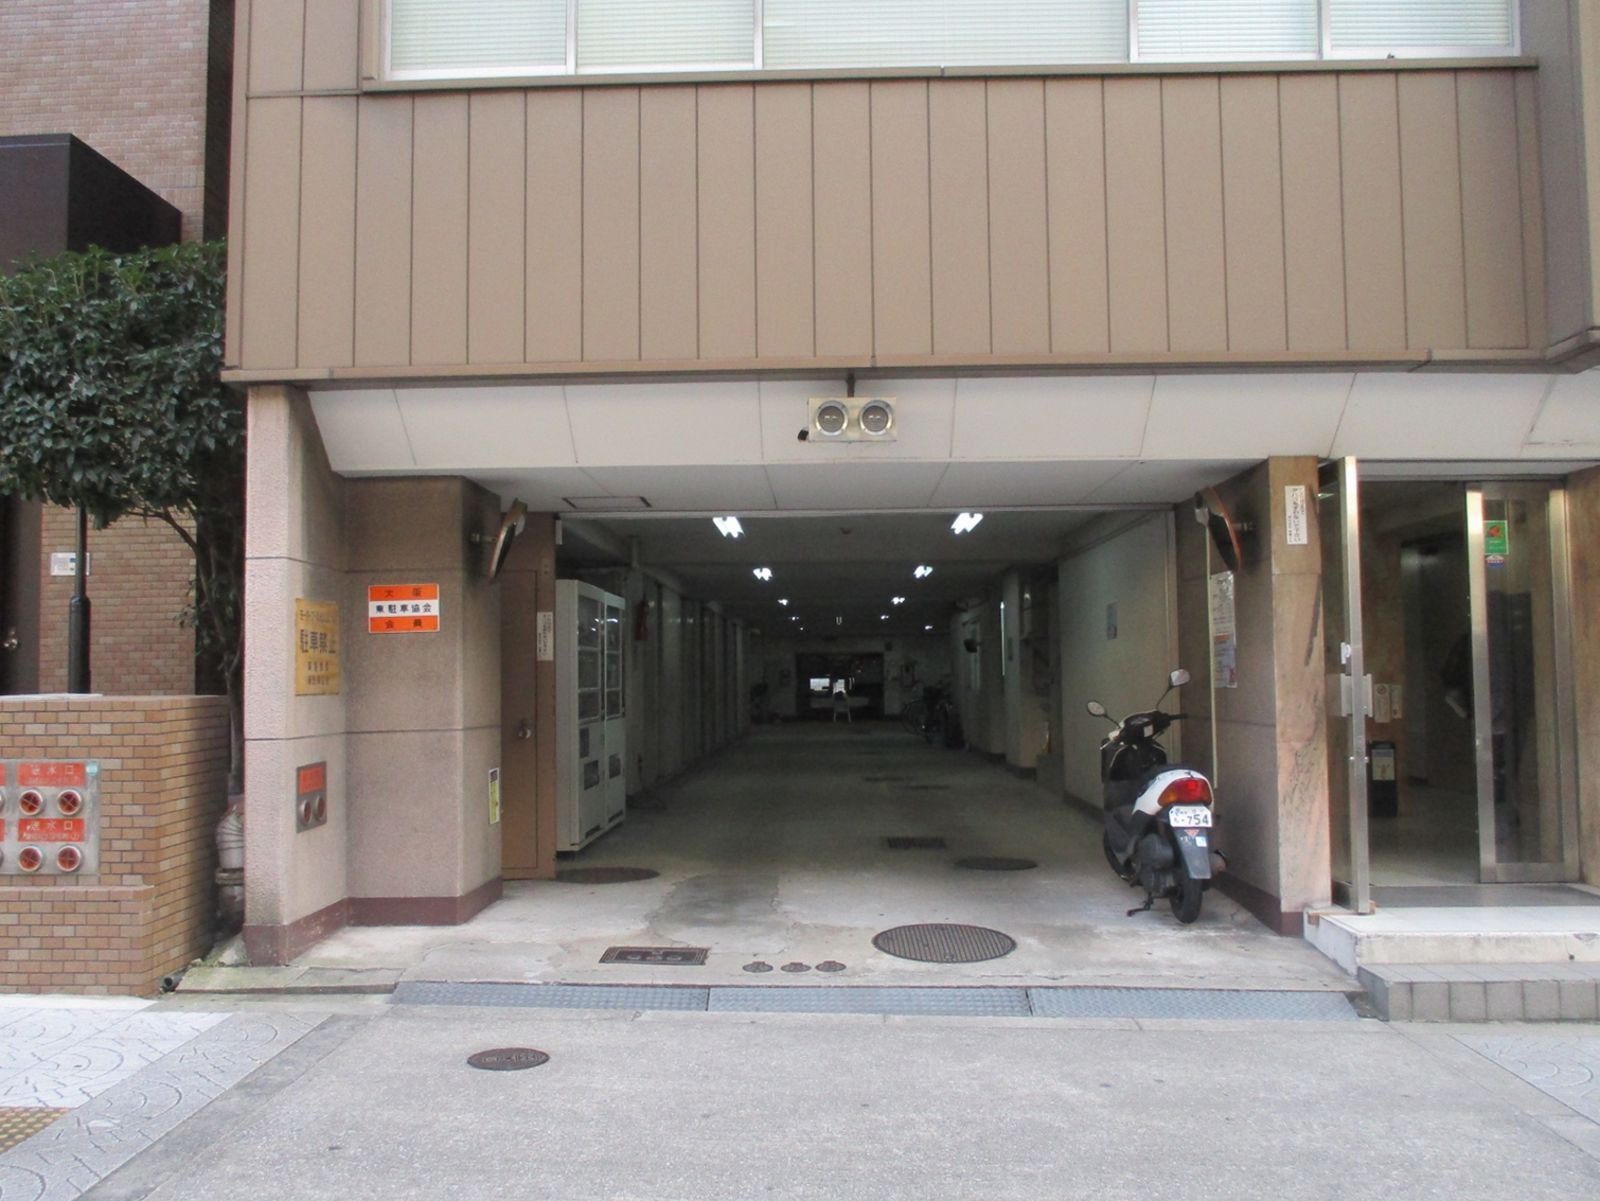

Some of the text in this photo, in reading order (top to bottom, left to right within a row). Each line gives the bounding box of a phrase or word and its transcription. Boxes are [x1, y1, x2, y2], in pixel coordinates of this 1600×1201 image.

[376, 603, 431, 614] 東駐車協会
